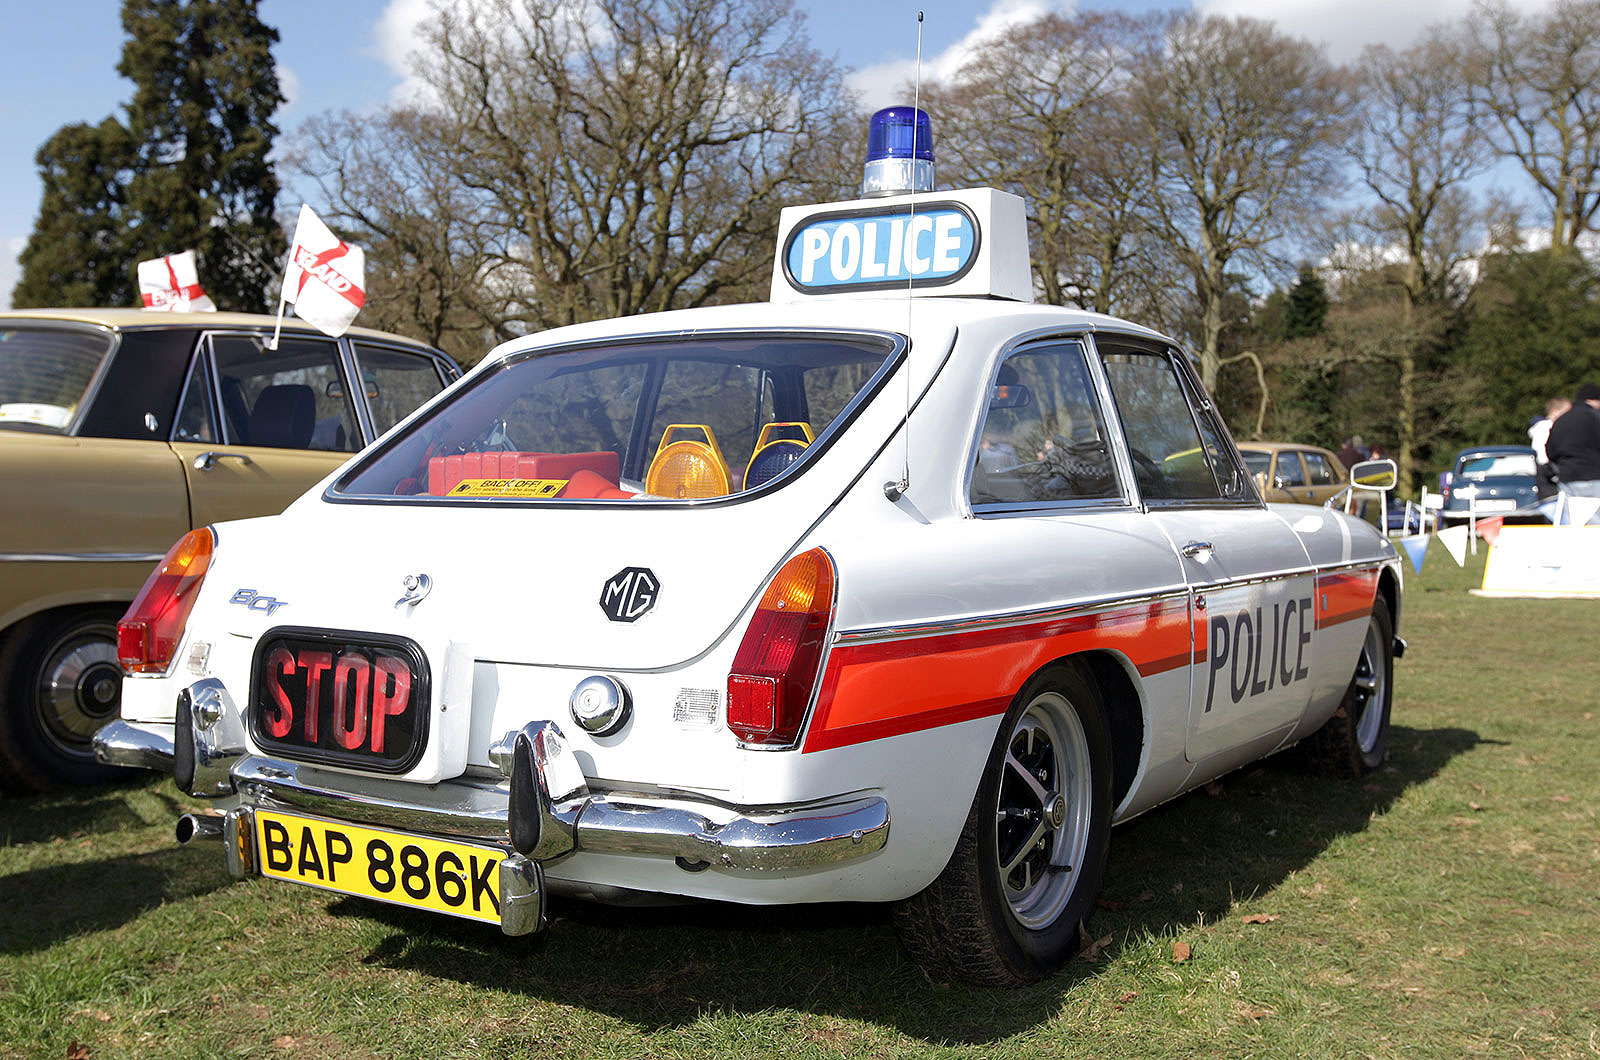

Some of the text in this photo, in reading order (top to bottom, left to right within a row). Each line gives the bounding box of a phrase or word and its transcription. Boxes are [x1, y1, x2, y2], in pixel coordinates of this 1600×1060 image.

[801, 213, 962, 283] POLICE
[480, 479, 542, 488] BACK OFF!
[604, 571, 655, 617] MG
[1205, 597, 1312, 713] POLICE
[263, 647, 411, 753] STOP
[263, 819, 500, 916] BAP 886K
